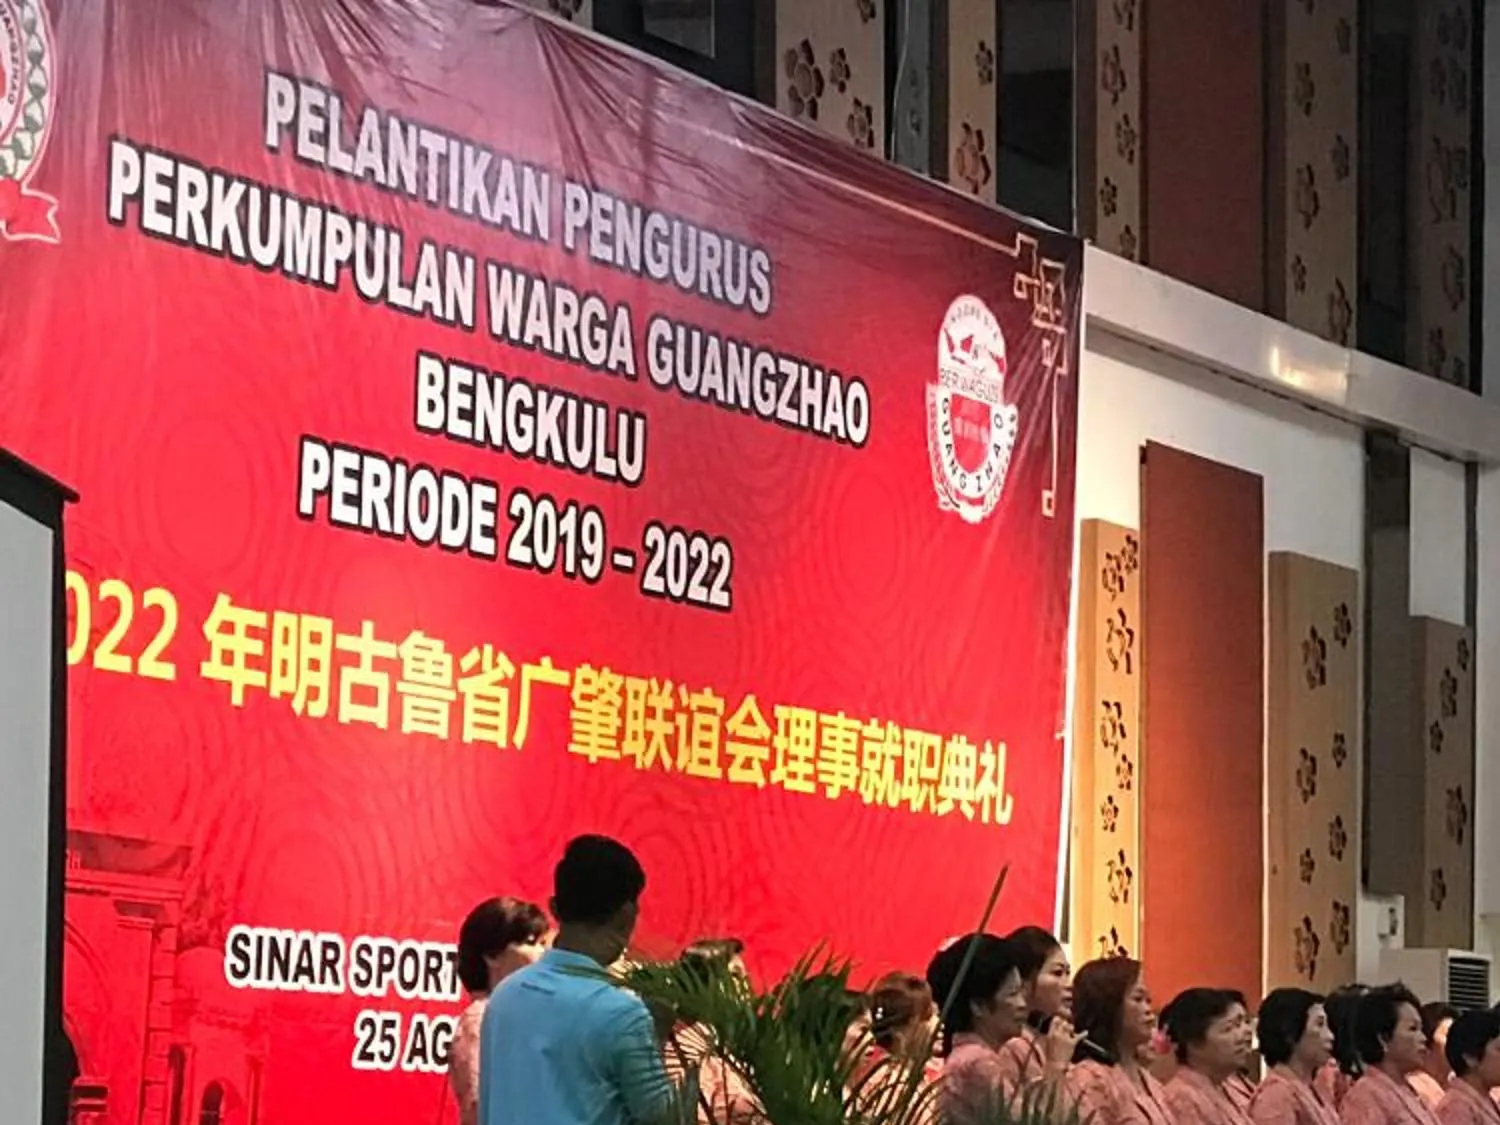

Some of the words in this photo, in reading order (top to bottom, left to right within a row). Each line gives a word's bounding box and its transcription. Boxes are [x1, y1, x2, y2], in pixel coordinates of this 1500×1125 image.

[263, 70, 552, 243] PELANTIKAN
[562, 183, 773, 315] PENGURUS
[107, 138, 476, 330] PERKUMPULAN
[486, 262, 637, 378] WARGA
[646, 317, 871, 445] GUANGZHAO
[414, 354, 647, 483] BENGKULU
[298, 439, 498, 558] PERIODE
[506, 491, 605, 580] 2019
[641, 524, 732, 609] 2022
[228, 930, 343, 987] SINAR
[356, 1014, 398, 1065] 25
